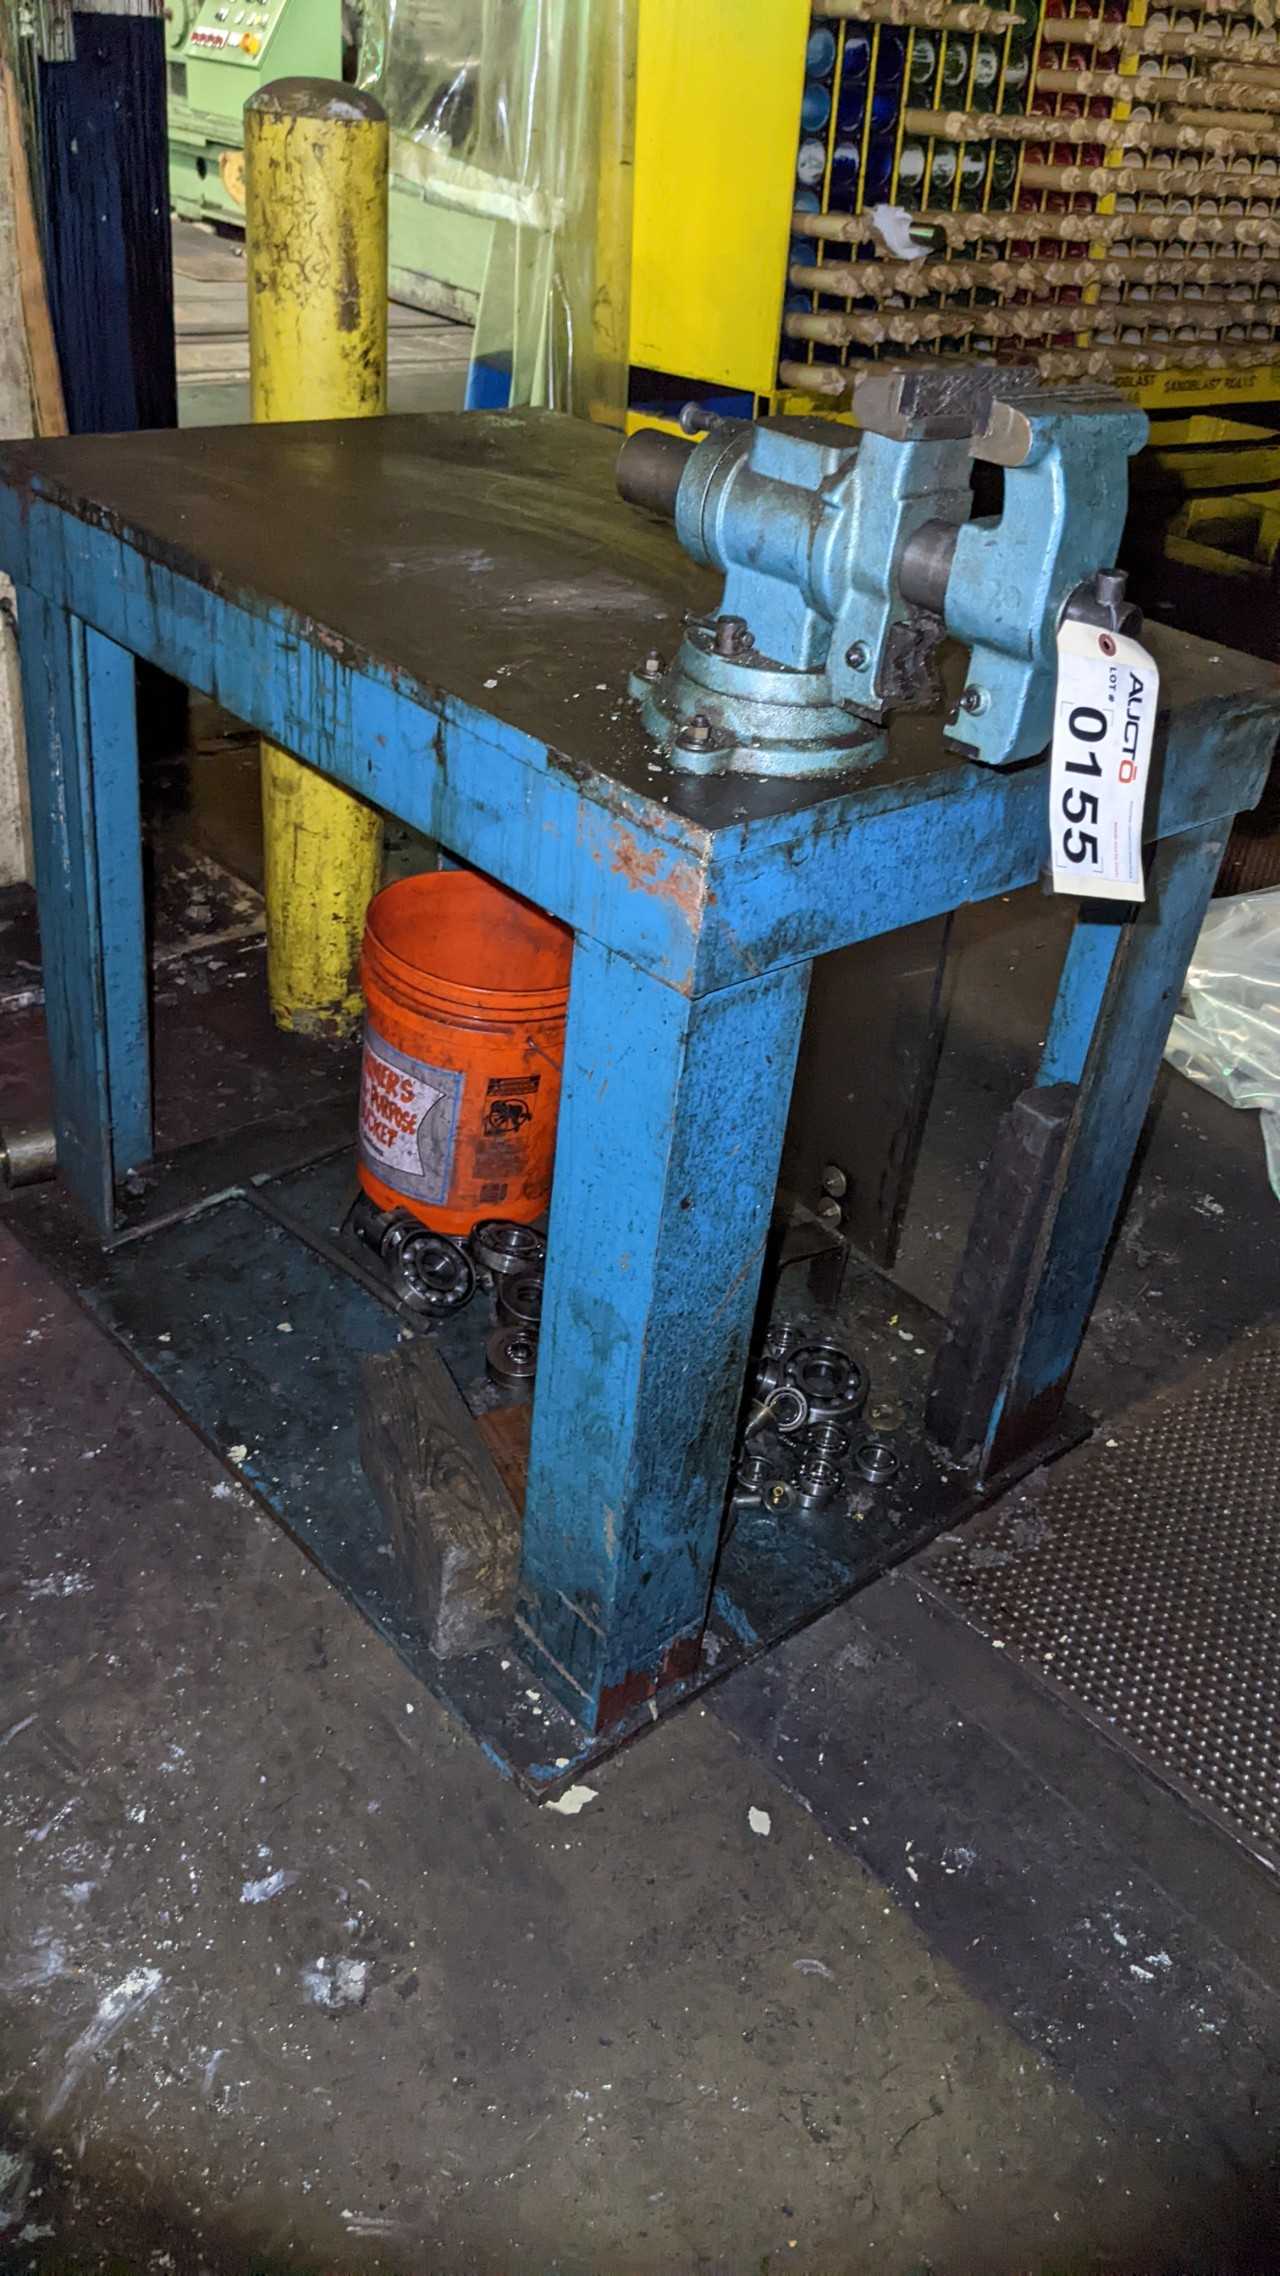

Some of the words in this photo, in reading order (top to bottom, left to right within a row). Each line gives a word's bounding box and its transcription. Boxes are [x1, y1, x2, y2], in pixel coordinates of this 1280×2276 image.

[1163, 377, 1221, 392] SANDBLAST
[1108, 666, 1118, 692] LOT
[1062, 706, 1108, 864] 0155
